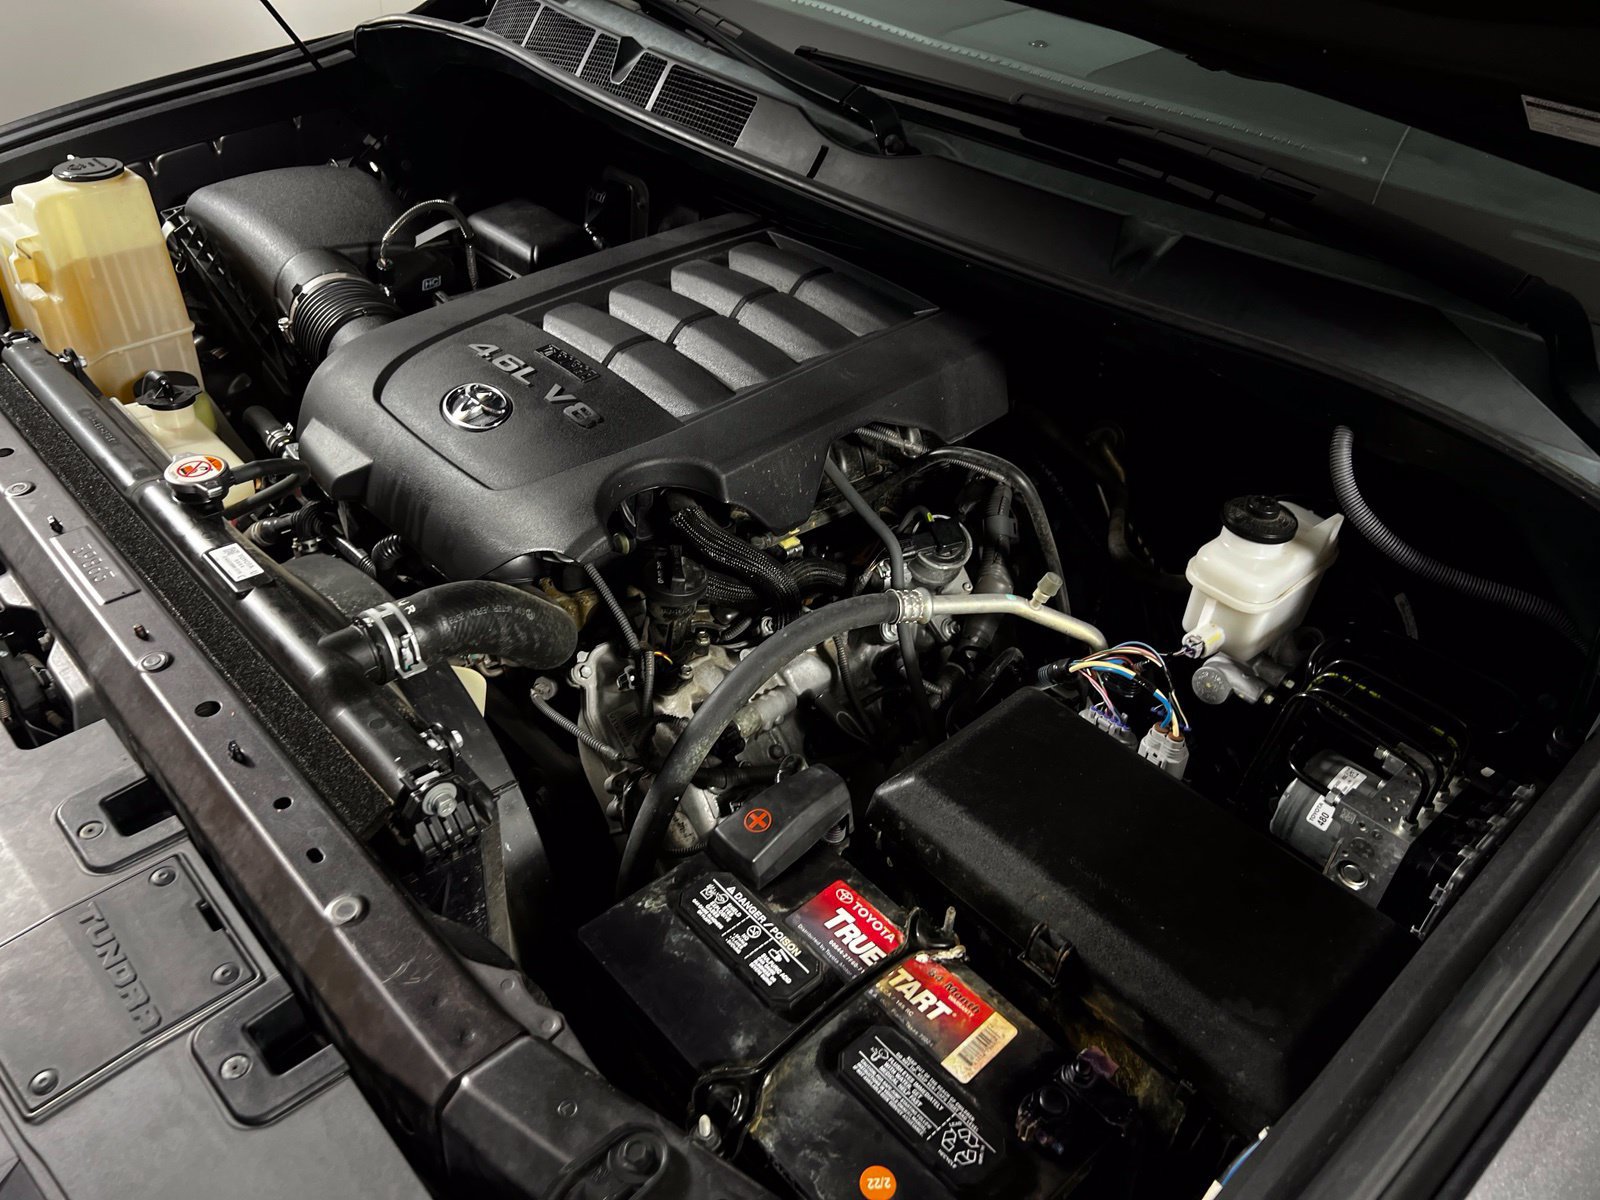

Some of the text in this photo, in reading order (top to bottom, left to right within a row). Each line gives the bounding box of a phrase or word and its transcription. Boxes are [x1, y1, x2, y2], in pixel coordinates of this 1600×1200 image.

[544, 383, 605, 429] V8
[1309, 802, 1325, 822] TOYOTA
[1317, 812, 1330, 826] 480
[733, 891, 767, 924] DANGER
[769, 926, 802, 957] POISON
[823, 907, 887, 966] TRUE
[852, 901, 896, 944] TOYOTA
[78, 900, 163, 1035] TUNDRA
[888, 968, 951, 1020] TART
[866, 1176, 892, 1191] 2/22
